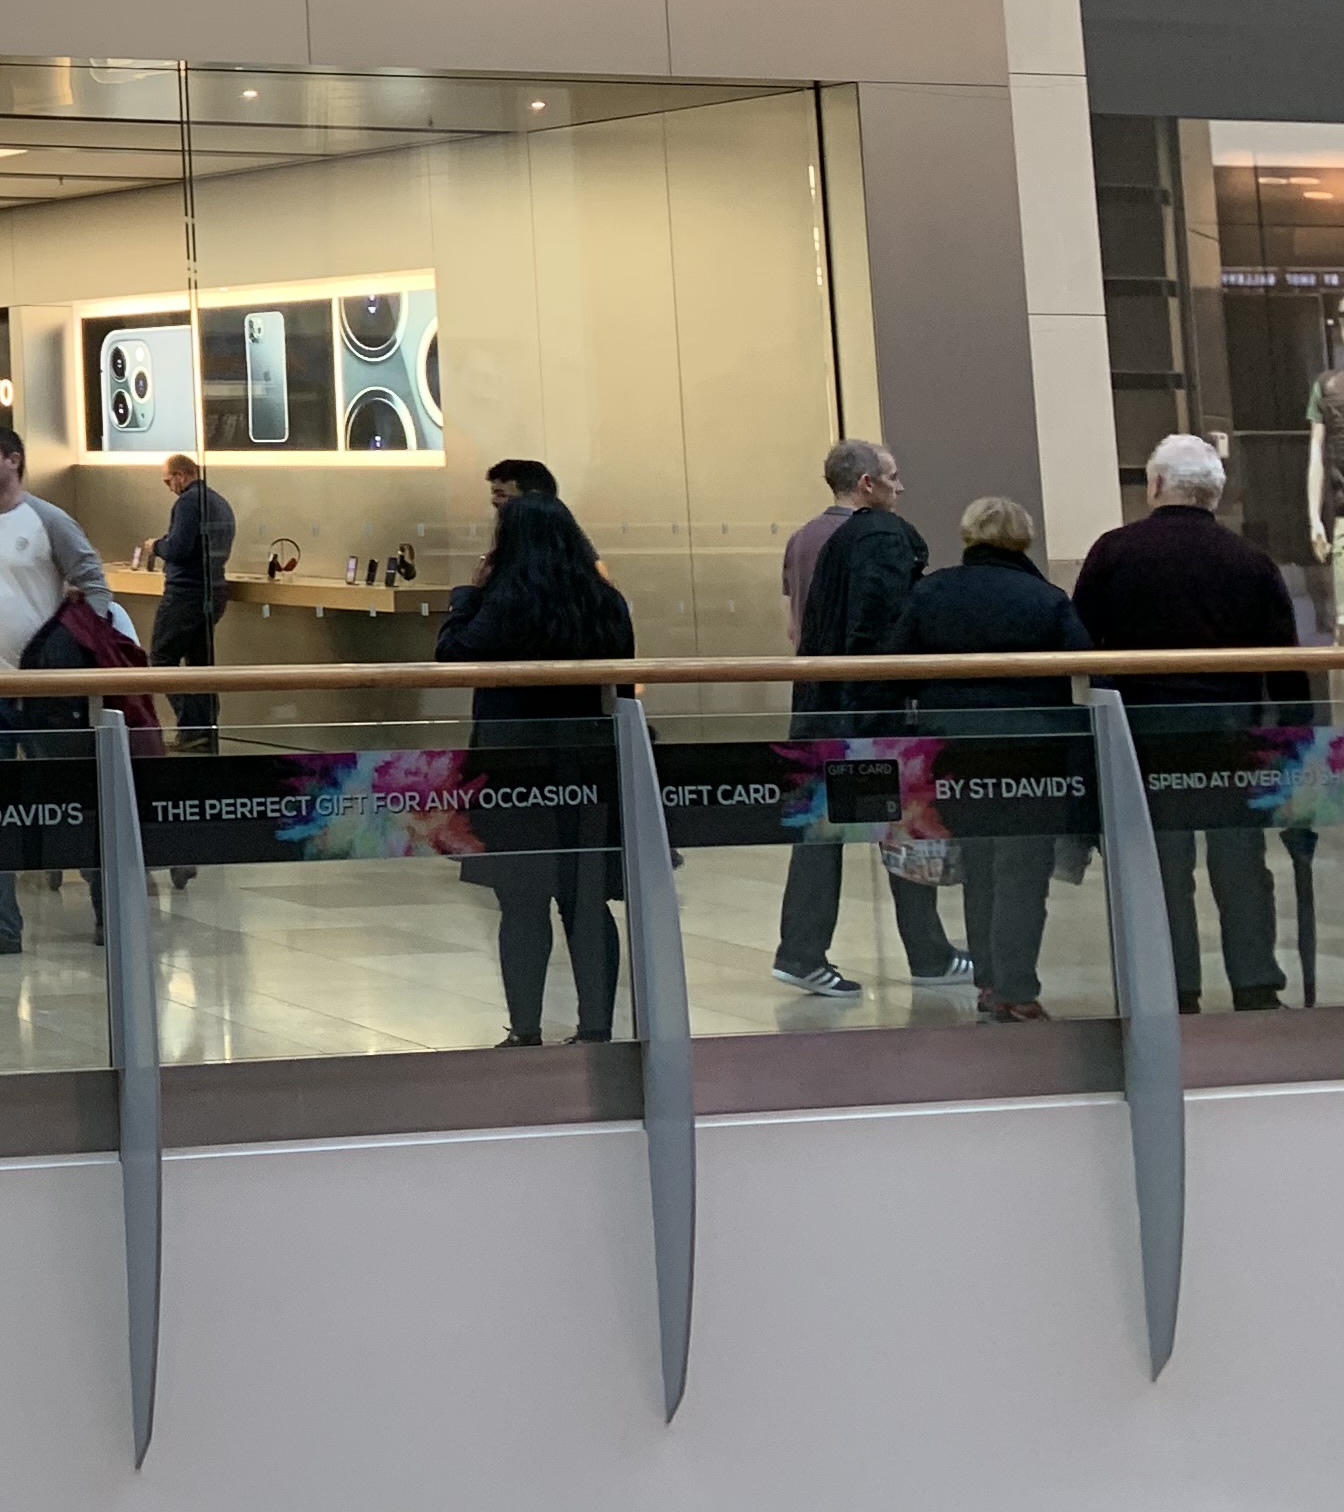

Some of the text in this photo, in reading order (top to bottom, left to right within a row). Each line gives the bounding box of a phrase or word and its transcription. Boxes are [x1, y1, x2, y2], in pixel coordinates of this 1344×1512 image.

[858, 763, 892, 775] CARD
[1148, 772, 1207, 790] SPEND
[1210, 772, 1231, 788] AT
[1234, 770, 1282, 787] OVER
[153, 785, 598, 821] THE PERFECT GIFT FOR ANY OCCASION
[662, 775, 1086, 807] GIFT CARD BY ST DAVID'S
